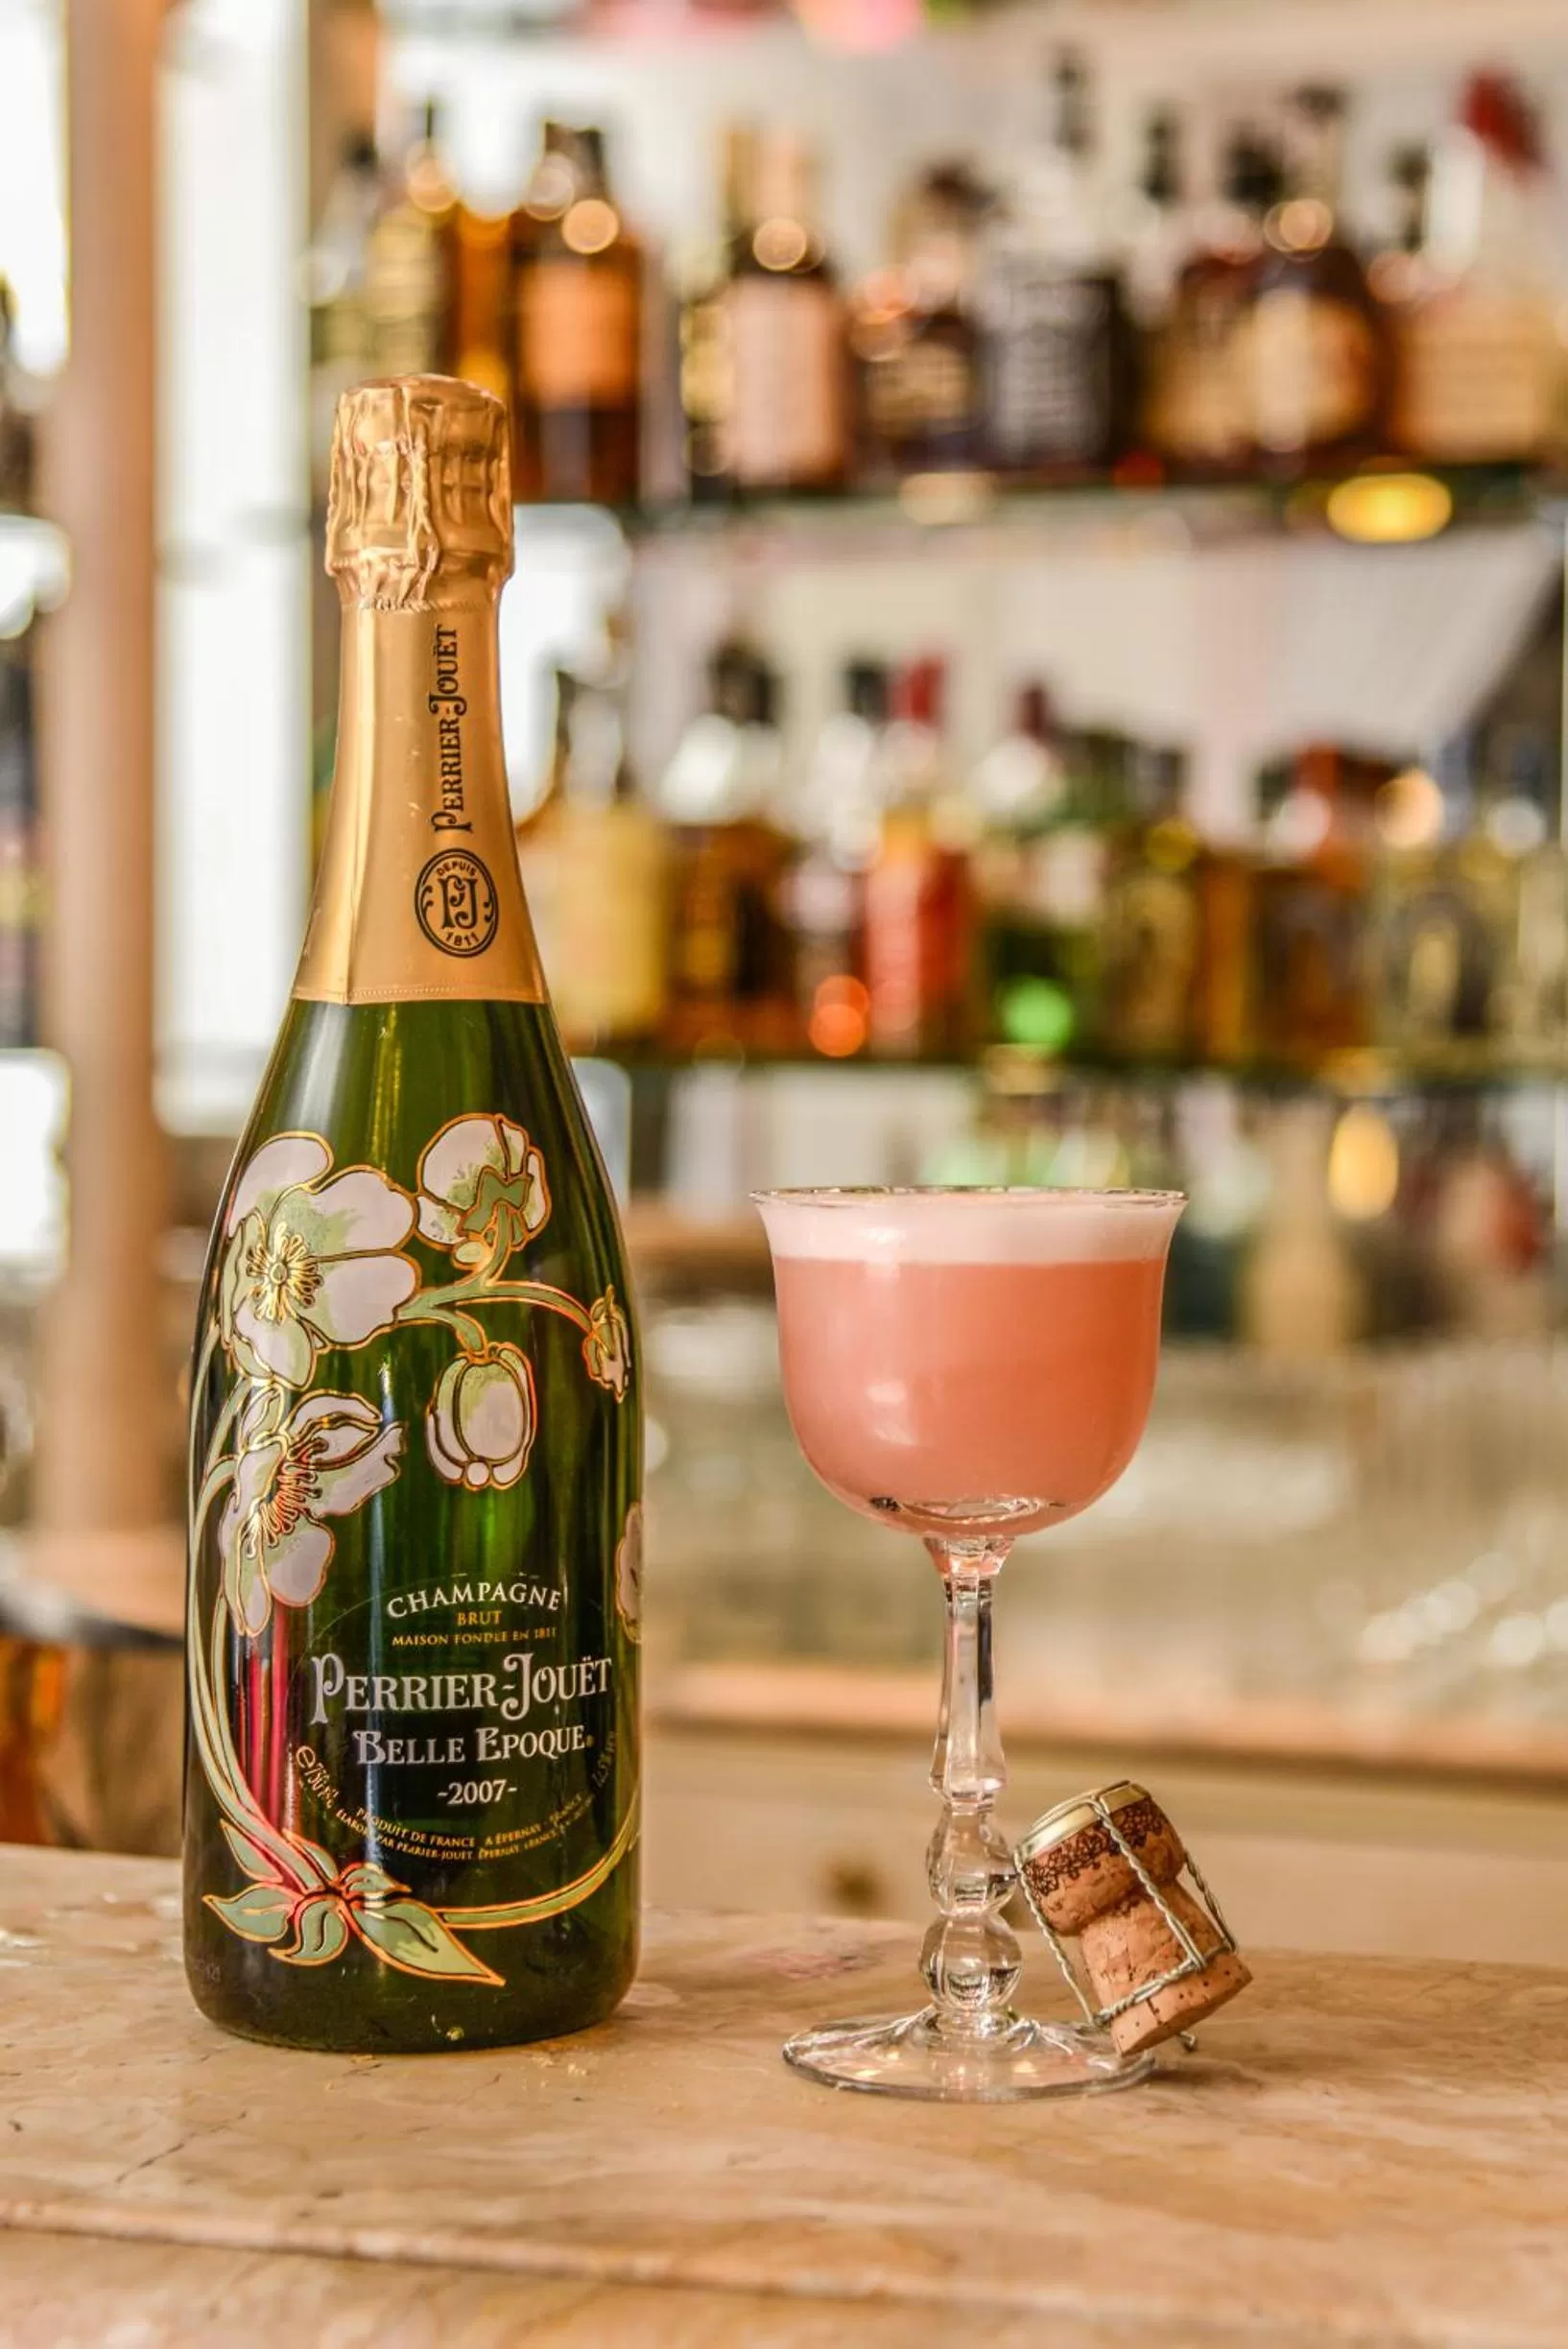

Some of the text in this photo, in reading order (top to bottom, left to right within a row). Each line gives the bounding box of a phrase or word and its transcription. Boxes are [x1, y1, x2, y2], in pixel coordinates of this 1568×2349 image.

[436, 861, 477, 876] DEPUIS
[445, 931, 480, 947] 1811
[387, 1581, 562, 1619] CHAMPAGNE
[456, 1610, 503, 1626] BRUT
[392, 1634, 448, 1647] MAISON
[512, 1632, 529, 1642] EN
[310, 1652, 613, 1725] PERRIER-JOUËT
[352, 1730, 466, 1766] BELLE
[375, 1834, 394, 1849] PAR
[411, 1831, 428, 1843] DE
[429, 1835, 476, 1848] FRANCE
